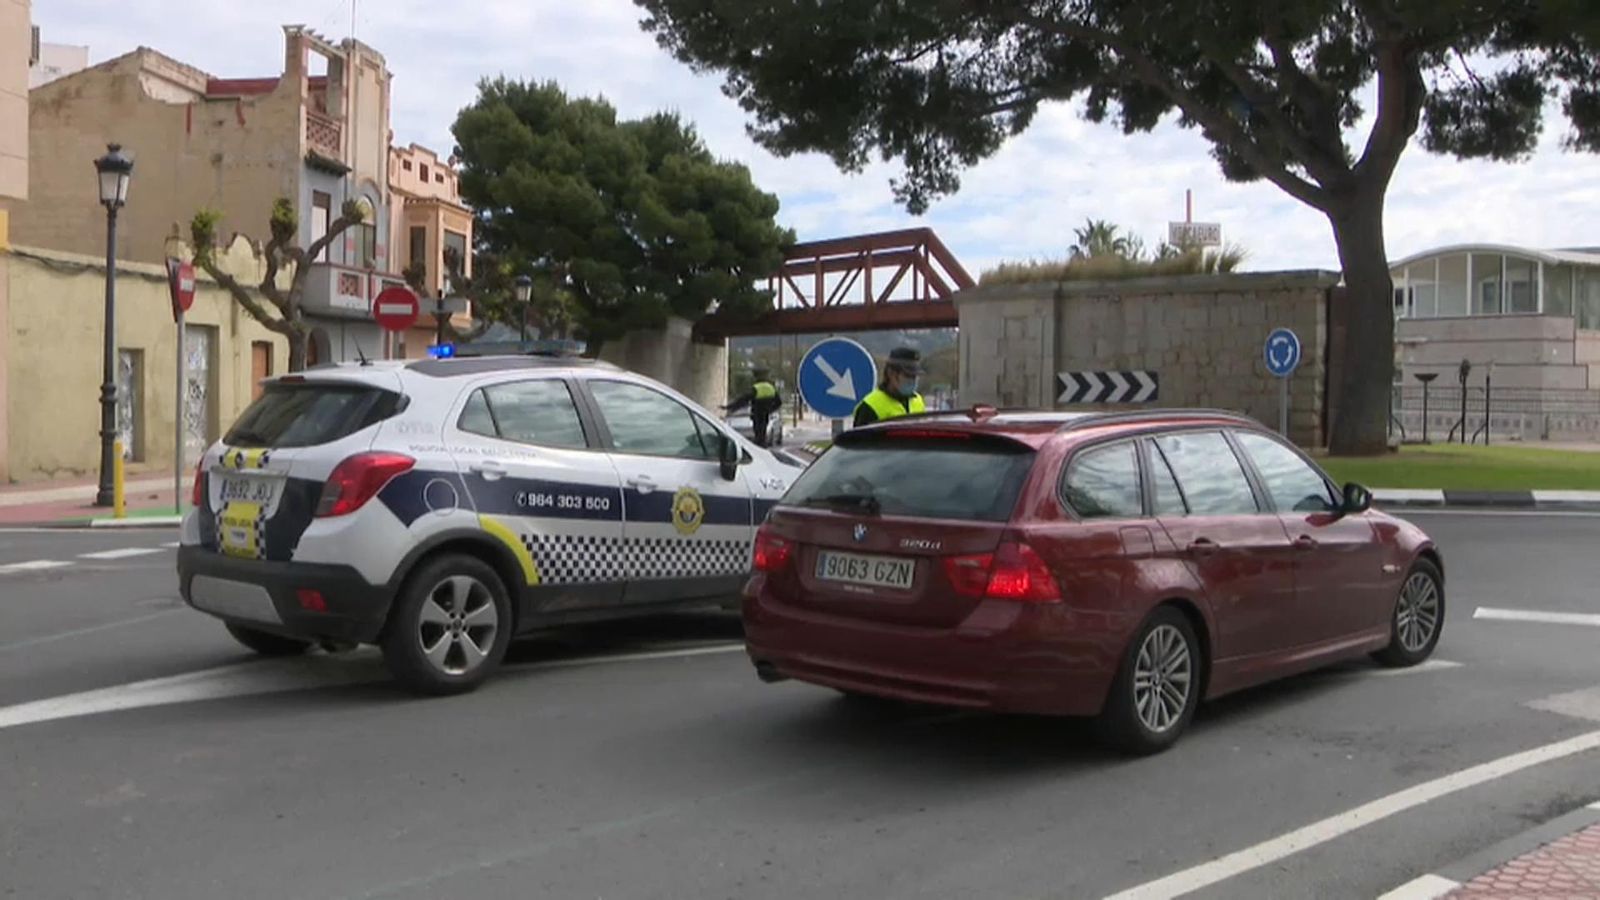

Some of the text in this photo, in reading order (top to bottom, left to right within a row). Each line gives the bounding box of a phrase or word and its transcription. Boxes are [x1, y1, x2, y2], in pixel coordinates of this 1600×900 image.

[527, 492, 553, 507] 964
[557, 495, 582, 509] 303
[827, 556, 910, 585] 9063 GZN
